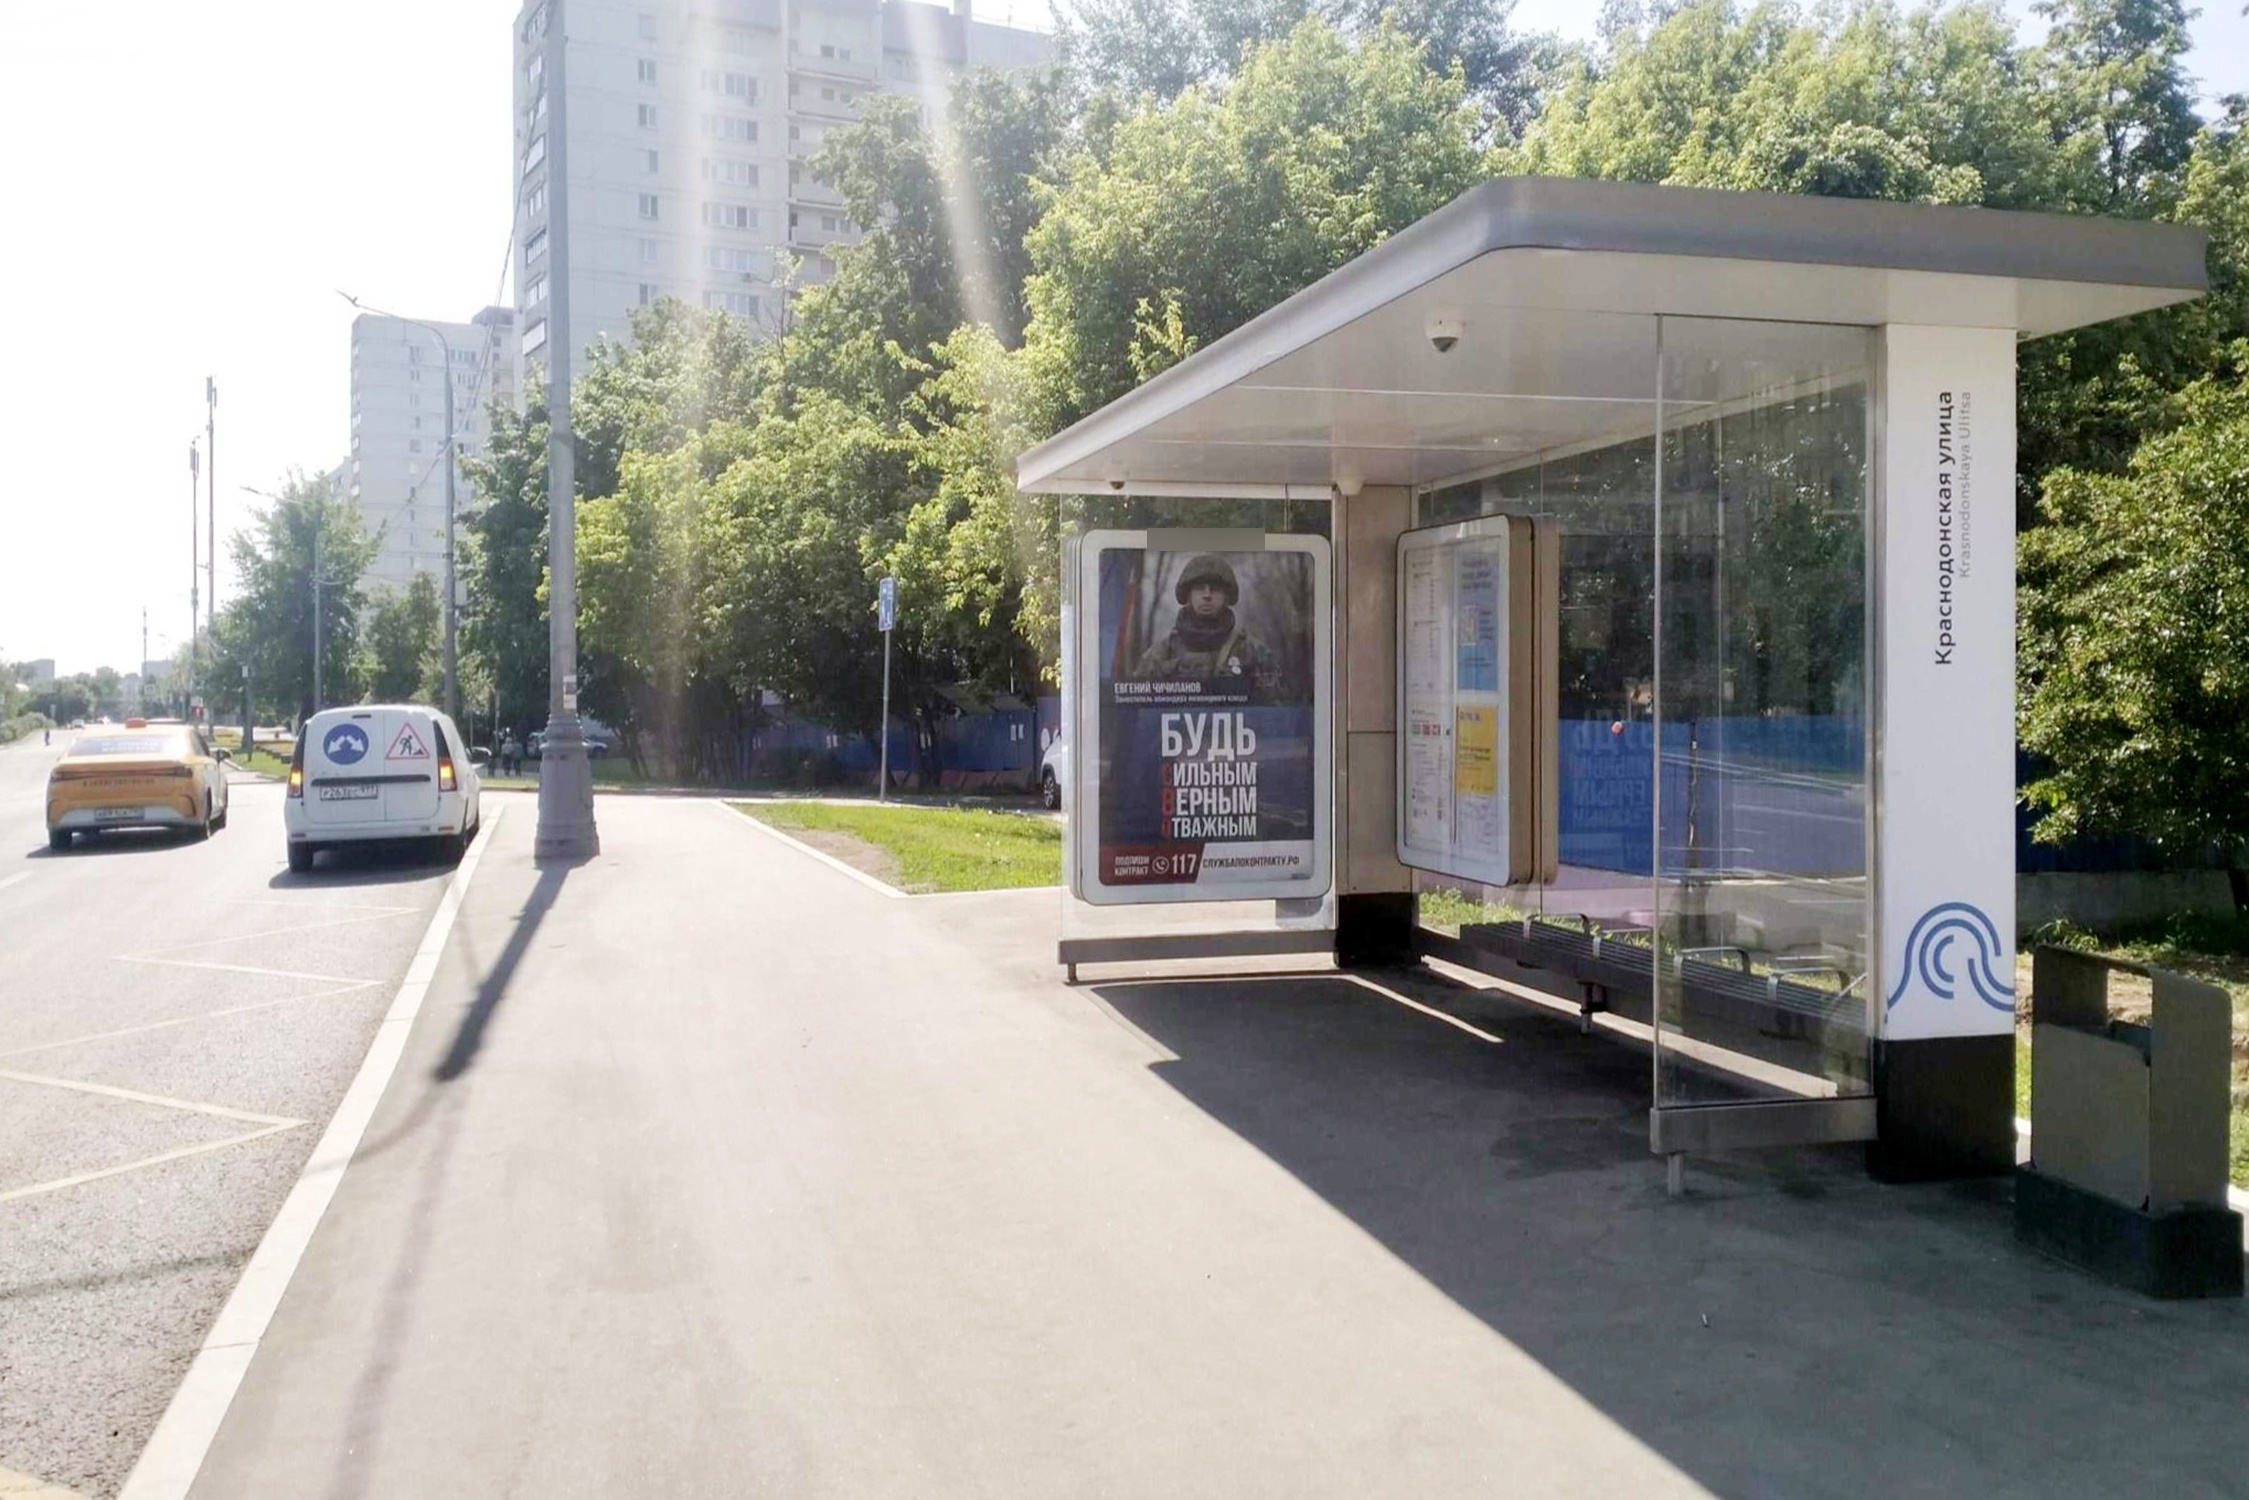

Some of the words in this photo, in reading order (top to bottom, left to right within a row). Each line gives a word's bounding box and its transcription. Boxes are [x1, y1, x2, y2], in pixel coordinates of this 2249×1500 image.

[1939, 391, 1955, 465] улица
[1959, 391, 1971, 439] Ulitsa
[1959, 445, 1972, 579] Krasnodonskaya
[1935, 472, 1956, 665] Краснодонская
[1114, 681, 1151, 694] ЕВГЕНИЙ
[1161, 712, 1256, 762] БУДЬ
[1162, 762, 1257, 787] СИЛЬНЫМ
[1162, 786, 1257, 816] ВЕРНЫМ
[1162, 815, 1257, 838] ОТВАЖНЫМ
[1115, 866, 1149, 876] КОНТРАКТ
[1172, 854, 1197, 874] 117
[1203, 855, 1300, 868] СЛУЖБАПОКОНТРАКТУ.РФ
